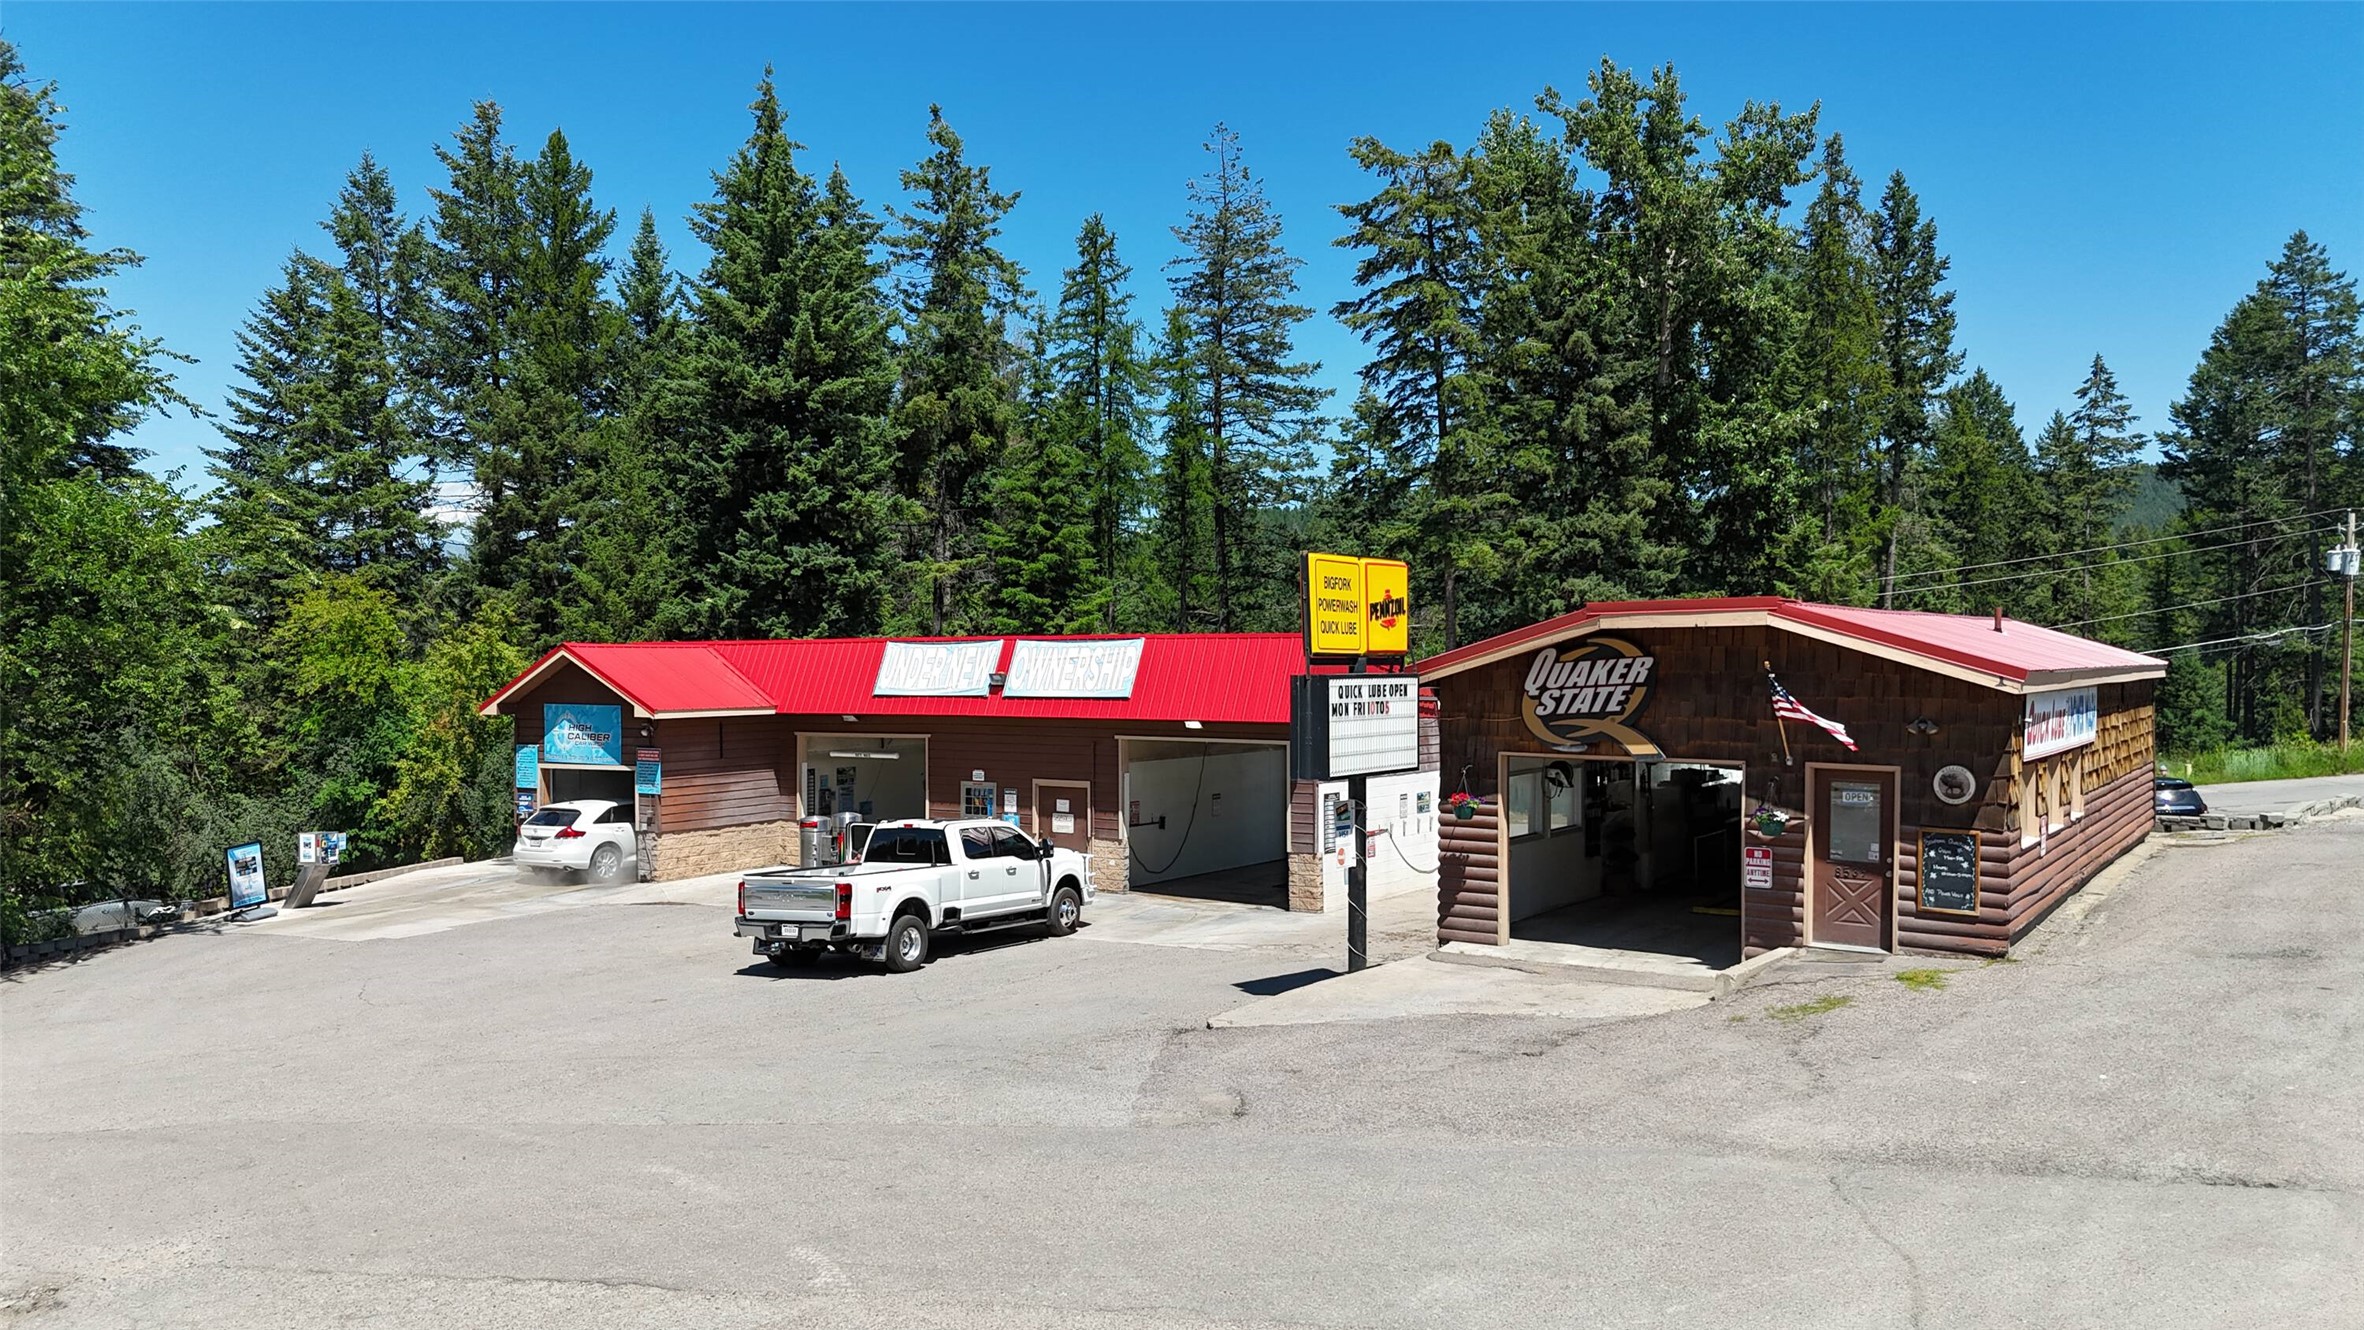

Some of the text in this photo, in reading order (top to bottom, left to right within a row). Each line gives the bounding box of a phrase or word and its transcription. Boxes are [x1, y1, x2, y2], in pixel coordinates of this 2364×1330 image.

[1323, 576, 1352, 591] BIGFORK
[1318, 598, 1358, 614] POWERWASH
[1369, 597, 1406, 622] PENNZOIL
[1320, 620, 1358, 635] QUICK LUBE
[883, 646, 996, 690] UNDER NEW
[1010, 645, 1138, 692] OWNERSHIP
[1524, 648, 1655, 696] QUAKER
[1338, 684, 1408, 699] QUICK LUBE OPEN
[1535, 685, 1632, 716] STATE
[1331, 703, 1349, 717] MON
[1353, 702, 1366, 716] FRI
[569, 724, 592, 732] HIGH
[567, 732, 611, 741] CALIBER
[1844, 792, 1869, 802] OPEN
[1746, 868, 1771, 877] ANYTIME
